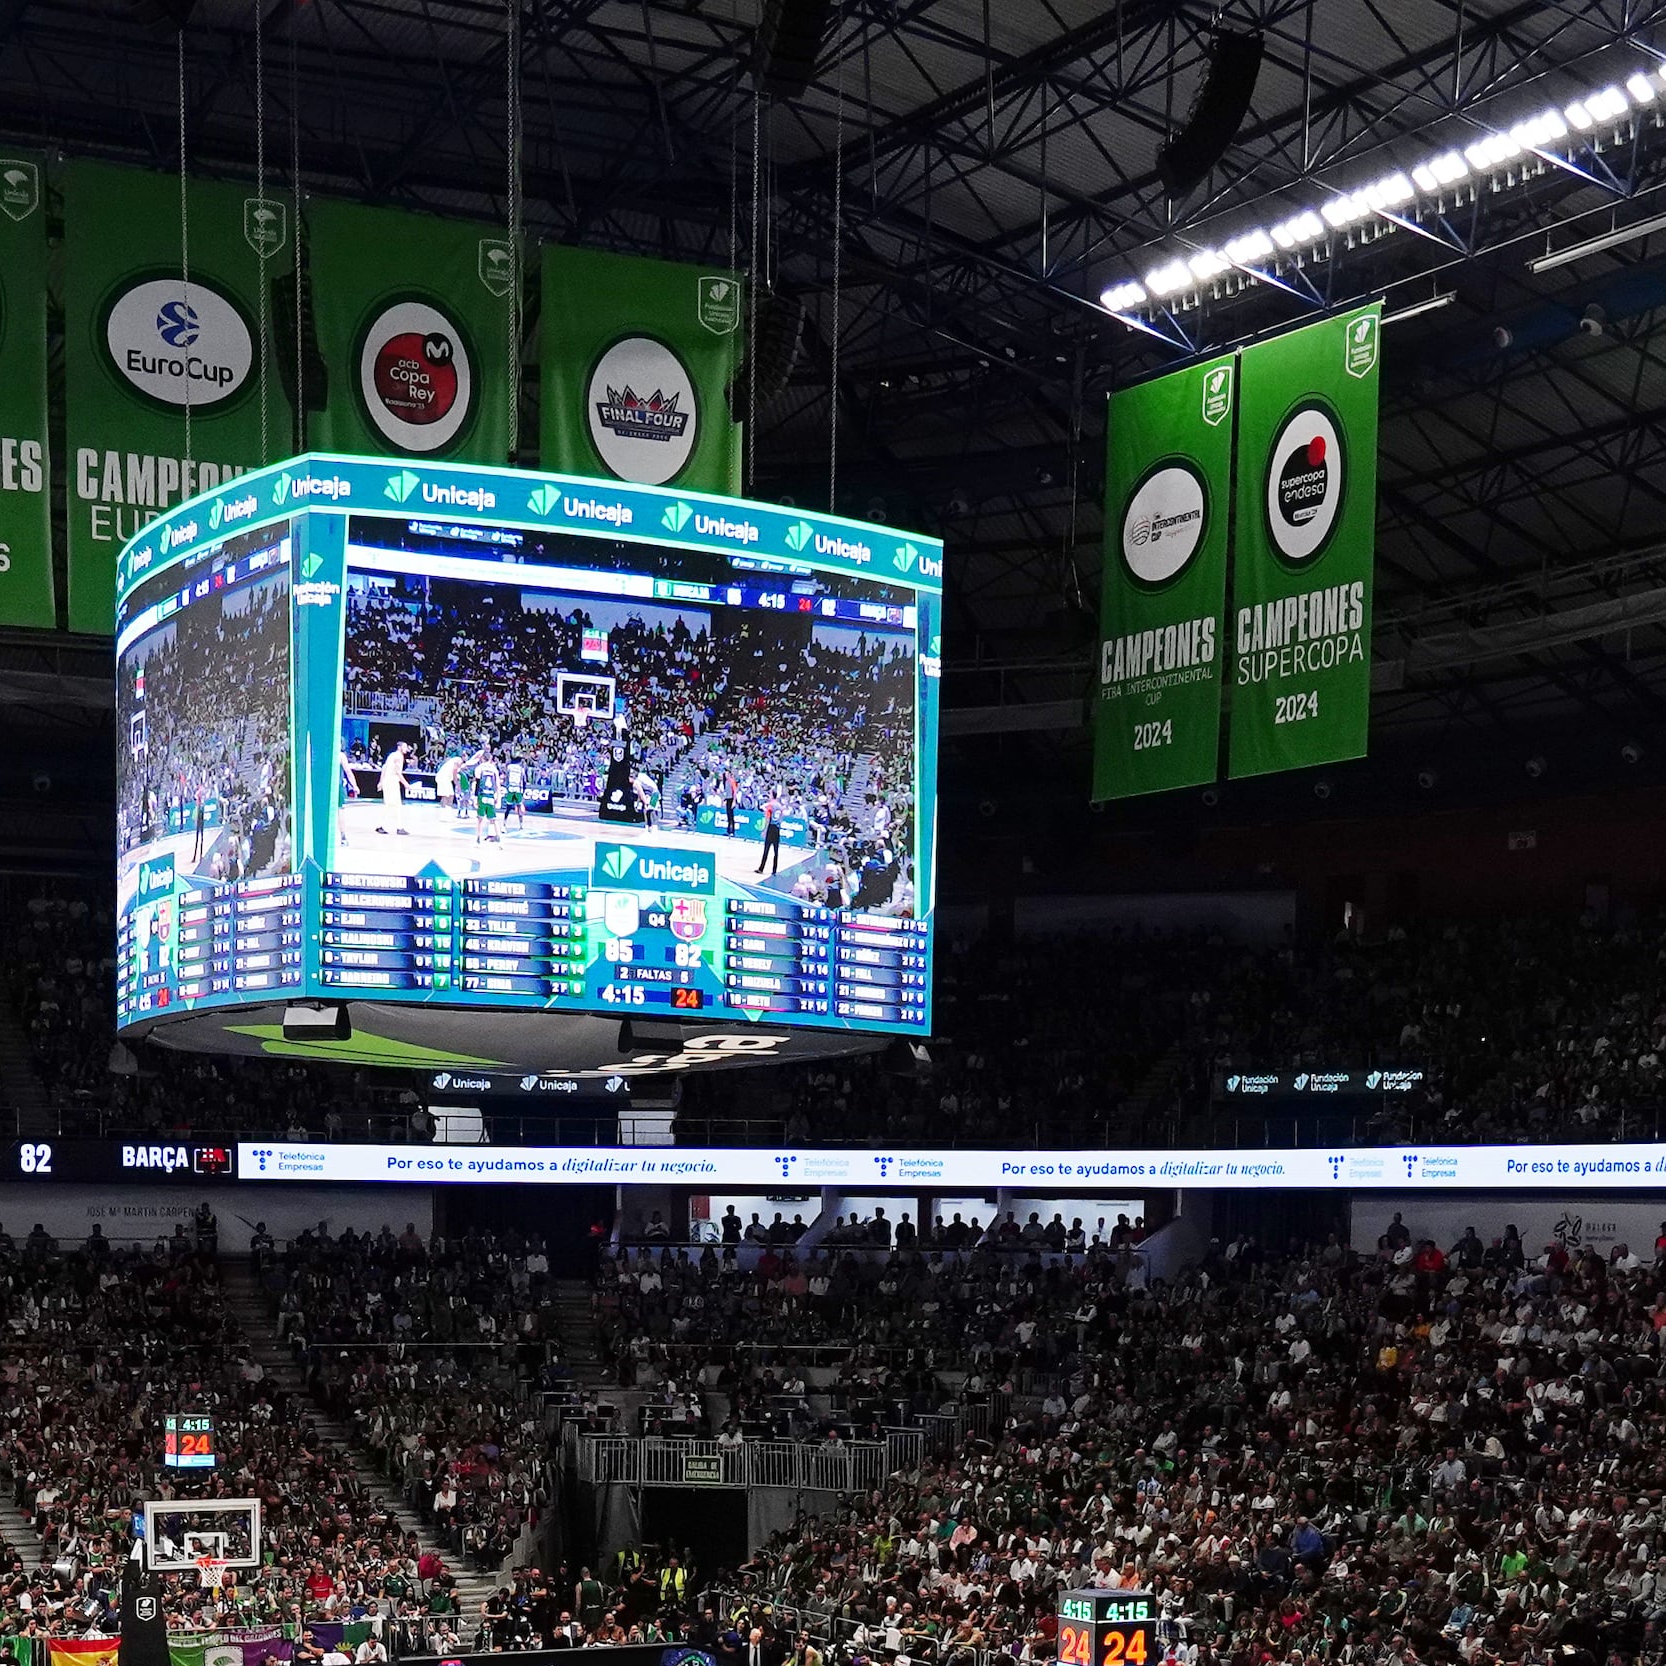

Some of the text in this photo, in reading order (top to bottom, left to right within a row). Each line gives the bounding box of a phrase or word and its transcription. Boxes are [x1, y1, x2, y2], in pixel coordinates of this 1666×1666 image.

[126, 348, 234, 388] EuroCup
[398, 359, 419, 369] acb
[390, 367, 429, 384] Copa
[409, 385, 435, 403] Rey
[601, 407, 643, 423] FINAL
[645, 412, 683, 428] FOUR
[291, 475, 351, 500] Unicaja
[1281, 470, 1325, 490] supercopa
[421, 484, 496, 512] Unicaja
[1284, 481, 1325, 503] endesa
[224, 495, 258, 522] Unicaja
[563, 498, 633, 526] Unicaja
[695, 514, 759, 543] Unicaja
[814, 534, 871, 563] Unicaja
[758, 590, 786, 610] 4:15
[1237, 581, 1364, 655] CAMPEONES
[1101, 616, 1216, 685] CAMPEONES
[1238, 633, 1364, 686] SUPERCOPA
[1275, 690, 1318, 724] 2024
[1134, 719, 1173, 751] 2024
[639, 858, 709, 888] Unicaja
[648, 913, 666, 927] Q4
[605, 938, 702, 968] 85 82
[637, 969, 673, 981] FALTAS
[602, 983, 699, 1007] 4:15 24
[452, 1078, 579, 1095] Unicaja Unicaja
[20, 1141, 53, 1173] 82
[121, 1146, 190, 1173] BARÇA
[277, 1150, 326, 1164] Telefónica
[387, 1156, 718, 1176] Por eso te ayudamos digitalizar negocio.
[897, 1157, 944, 1171] Telefónica
[1421, 1157, 1458, 1168] Telefónica
[1507, 1158, 1528, 1173] Por
[1531, 1161, 1555, 1173] eso
[1558, 1160, 1571, 1173] te
[1573, 1158, 1640, 1177] ayudamos
[277, 1162, 325, 1174] Empresas
[897, 1168, 943, 1180] Empresas
[1002, 1160, 1286, 1180] Por eso te ayudamos digitalizar negocio.
[1421, 1168, 1457, 1180] Empresas
[182, 1418, 211, 1432] 4:15
[181, 1435, 210, 1455] 24
[1062, 1600, 1092, 1621] 4:15
[1106, 1601, 1149, 1621] 4:15
[1060, 1628, 1091, 1666] 24
[1103, 1631, 1147, 1666] 24
